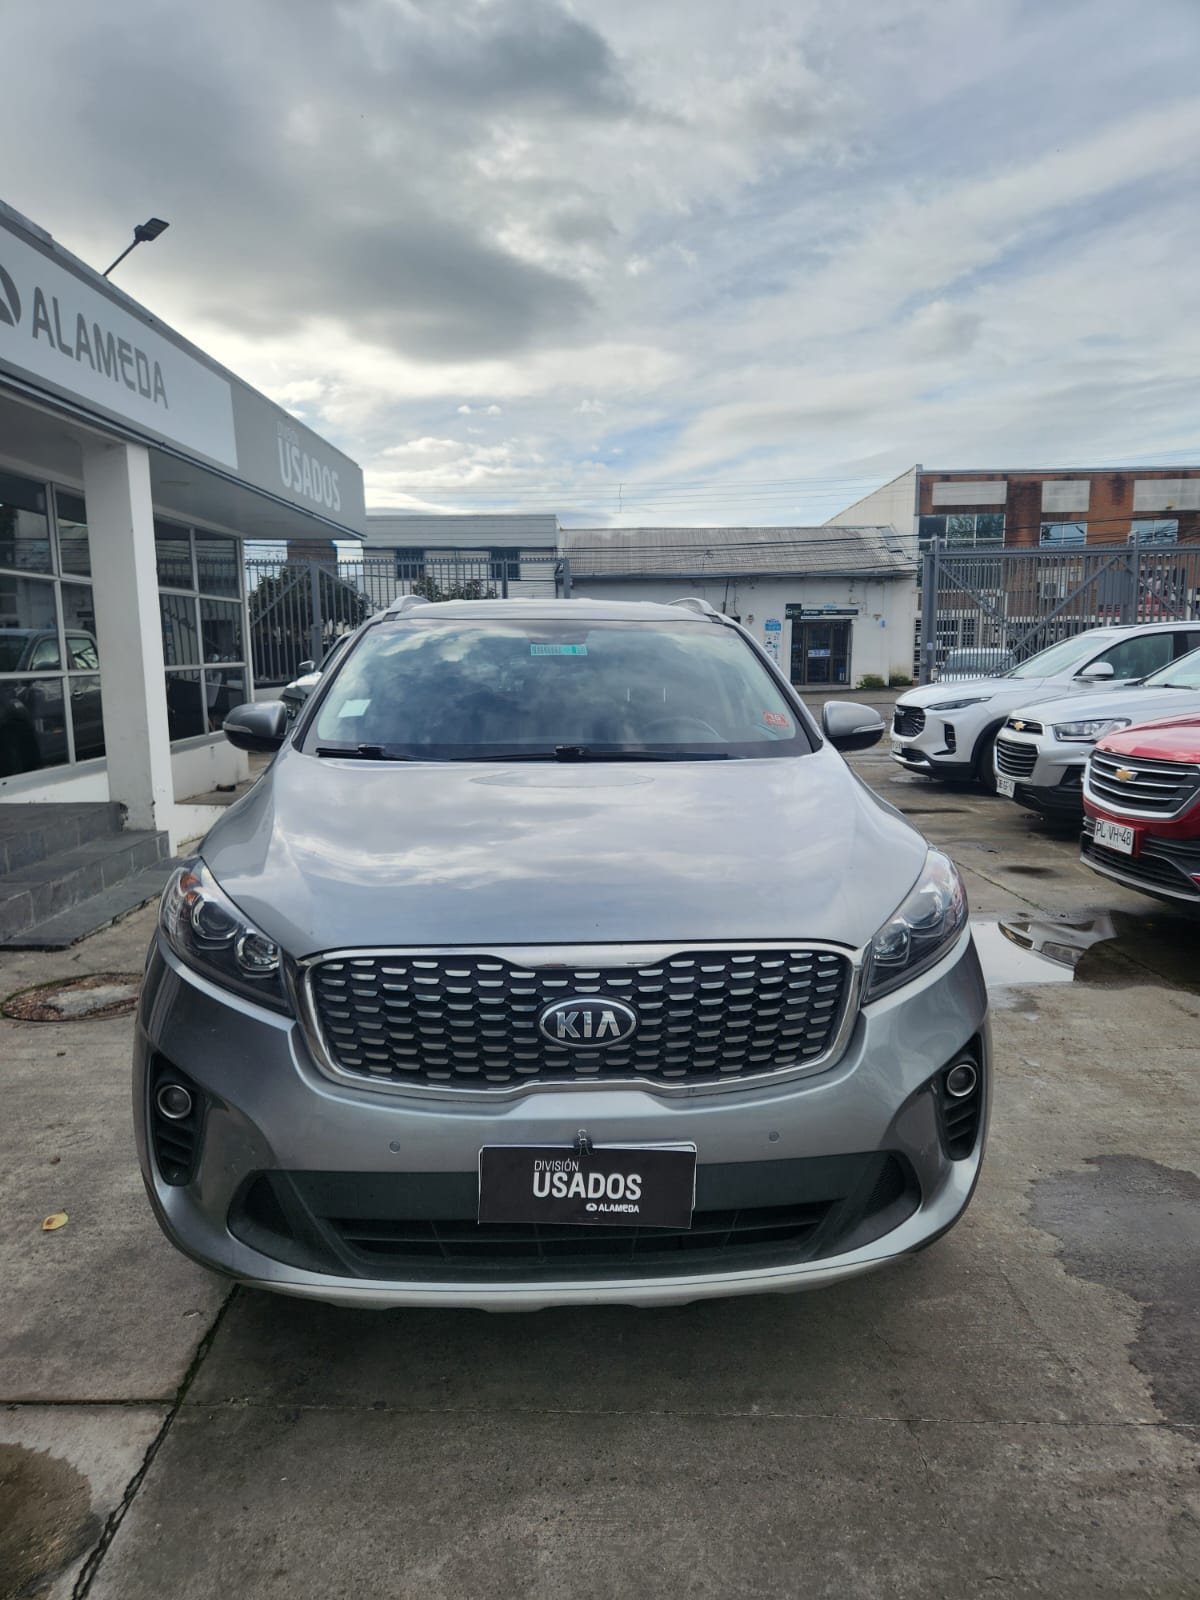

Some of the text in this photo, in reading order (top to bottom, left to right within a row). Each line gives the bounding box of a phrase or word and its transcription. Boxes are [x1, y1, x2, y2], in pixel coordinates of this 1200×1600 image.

[32, 286, 168, 410] ALAMEDA
[277, 436, 341, 512] USADOS
[556, 1010, 621, 1038] KIA
[534, 1158, 579, 1172] DIVISIÓN
[532, 1172, 642, 1201] USADOS
[598, 1203, 640, 1214] ALAMEDA
